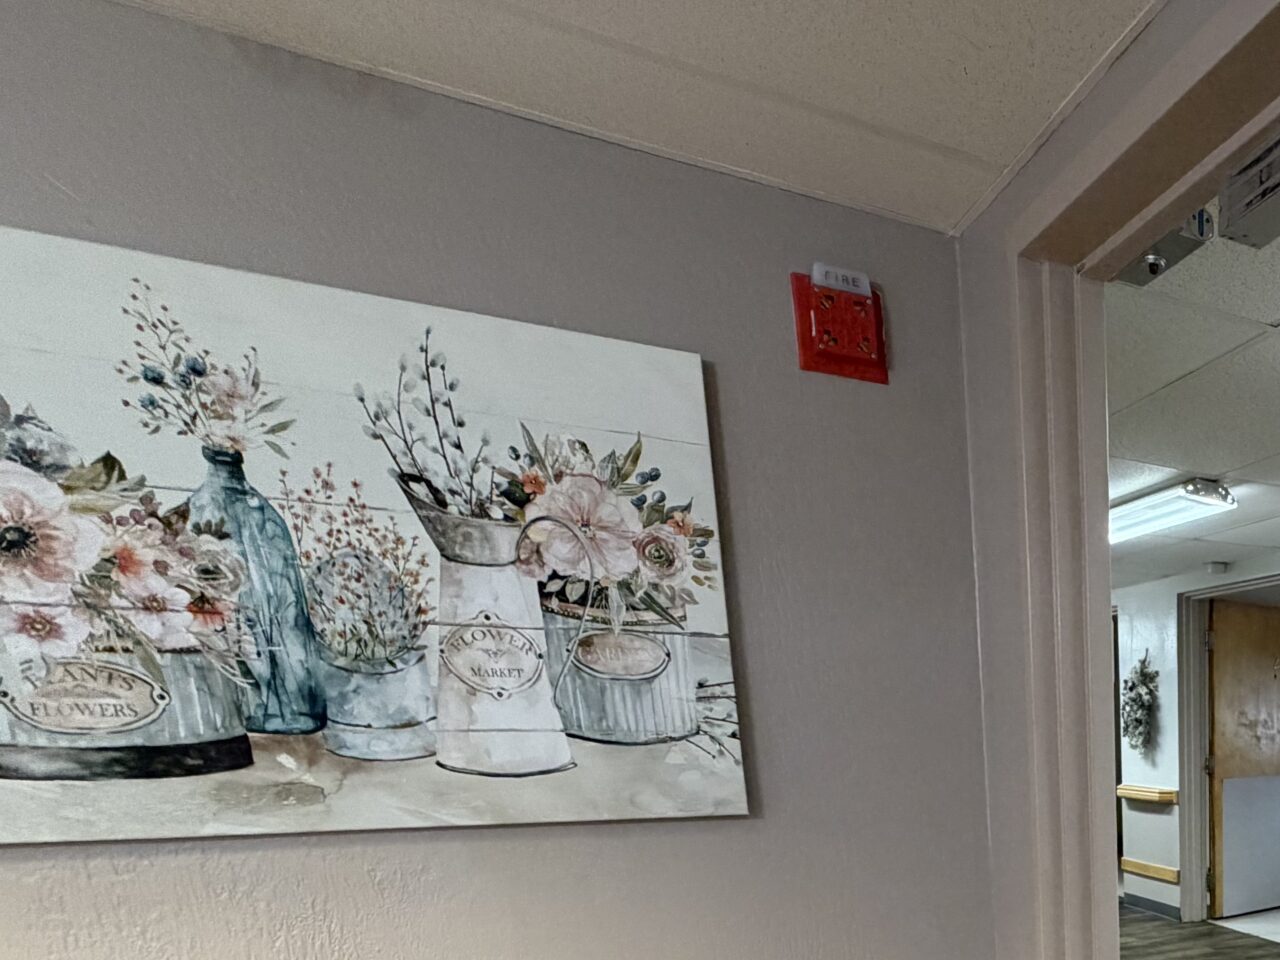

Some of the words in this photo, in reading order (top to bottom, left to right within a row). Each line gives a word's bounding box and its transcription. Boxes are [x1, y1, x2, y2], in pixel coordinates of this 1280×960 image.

[824, 270, 860, 288] FIRE
[450, 628, 532, 655] FLOWER
[23, 665, 136, 691] PANTS
[469, 665, 524, 678] MARKET
[29, 702, 139, 718] FLOWERS
